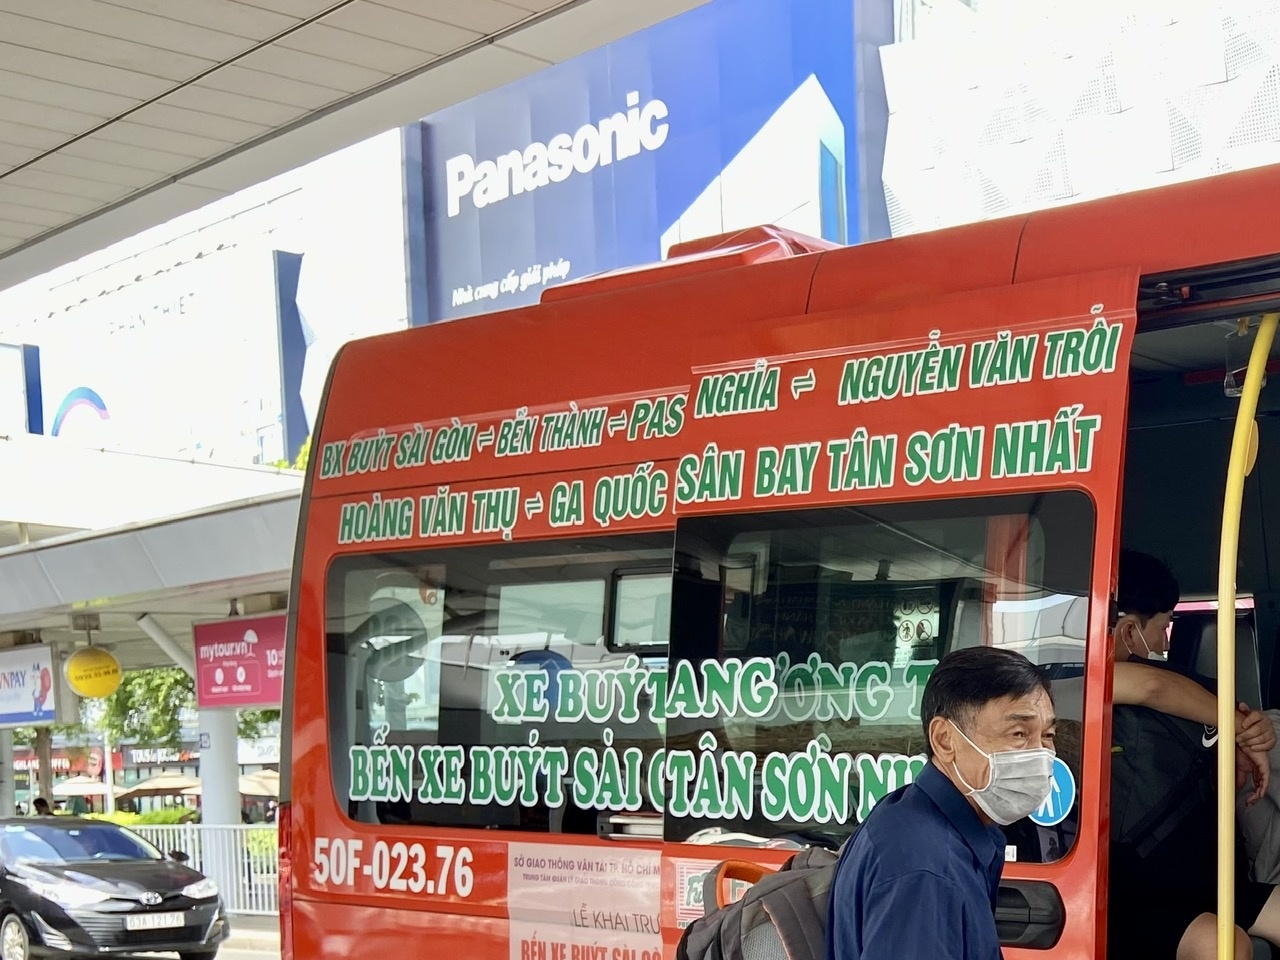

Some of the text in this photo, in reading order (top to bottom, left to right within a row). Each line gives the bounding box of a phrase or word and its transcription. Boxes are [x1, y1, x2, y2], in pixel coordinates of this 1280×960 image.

[446, 90, 669, 217] Panasonic
[694, 304, 1124, 418] NGHĨA NGUYỄN VĂN TRỖI
[320, 440, 348, 481] BX
[346, 428, 395, 476] BUÝT
[394, 424, 430, 469] SÀI
[430, 417, 478, 463] GÒN
[540, 402, 608, 451] THÀNH
[675, 404, 1102, 504] SÂN BAY TÂN SƠN NHẤT
[338, 462, 668, 544] HOÀNG VĂN THỤ GA QUỐC
[200, 641, 248, 662] mytour.vn
[491, 669, 550, 723] XE
[349, 721, 415, 803] BẾN
[417, 744, 466, 806] XE
[469, 729, 569, 808] BUÝT
[573, 727, 643, 811] SÀI
[666, 732, 756, 821] TÂN
[762, 739, 851, 825] SƠN
[314, 837, 474, 898] 50F-023.76
[526, 858, 546, 868] GIAO
[548, 857, 575, 871] THÔNG
[573, 903, 589, 928] LỄ
[593, 910, 629, 931] KHAI
